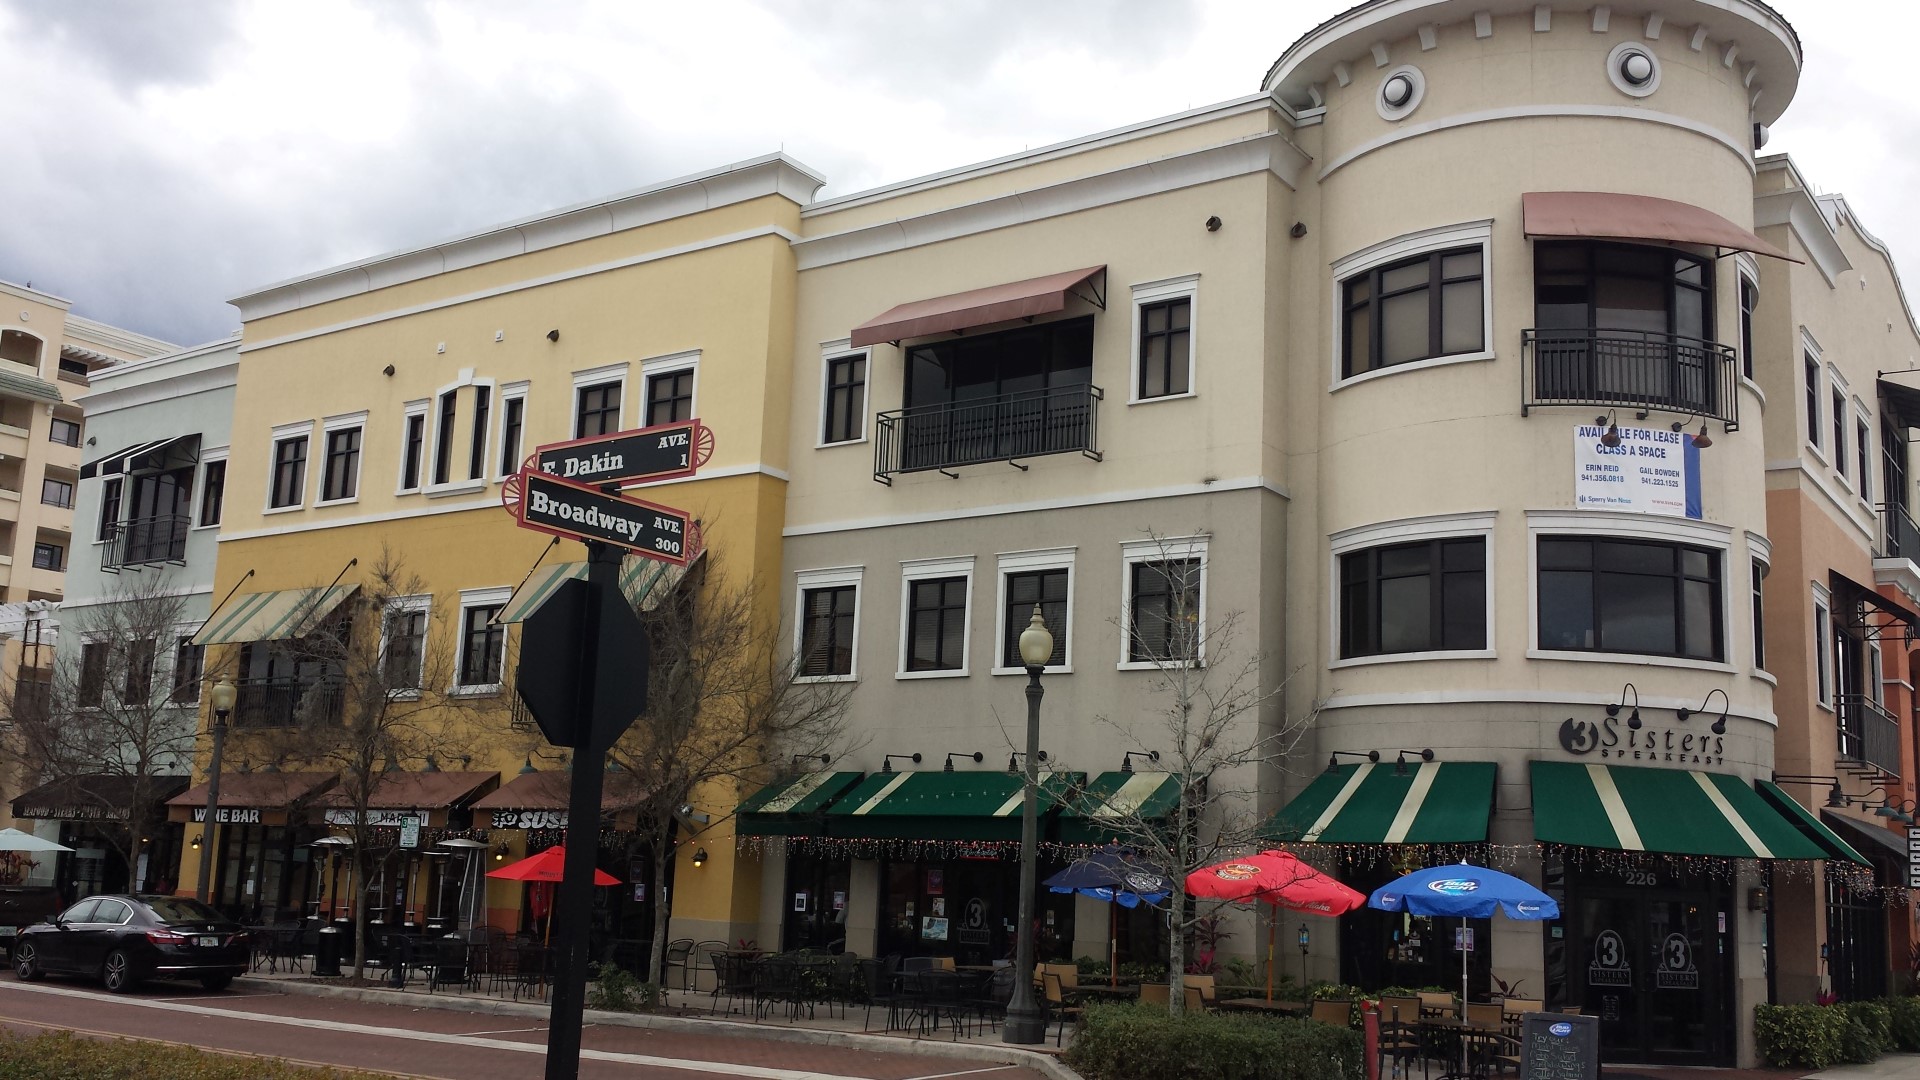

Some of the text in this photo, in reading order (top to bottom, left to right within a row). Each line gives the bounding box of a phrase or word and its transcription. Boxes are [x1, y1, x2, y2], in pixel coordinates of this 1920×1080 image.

[657, 433, 689, 449] AVE.
[1579, 427, 1679, 444] AVAILLE FOR LEASE
[1596, 443, 1666, 459] CLASS A SPACE
[563, 452, 624, 478] Dakin
[680, 453, 688, 467] 1
[1586, 464, 1619, 473] ERIN REID
[1639, 467, 1680, 478] GAIL BOWDEN
[530, 490, 643, 542] Broadway
[653, 516, 682, 534] AVE.
[655, 537, 680, 554] 300
[1602, 717, 1724, 755] Sisters
[1602, 750, 1723, 766] SPEAKEASY
[194, 808, 260, 823] WE BAR
[519, 811, 569, 829] SUS
[1626, 871, 1657, 886] 226
[970, 903, 981, 927] 3
[1602, 936, 1618, 966] 3
[1670, 940, 1686, 969] 3
[1532, 1032, 1548, 1043] Try
